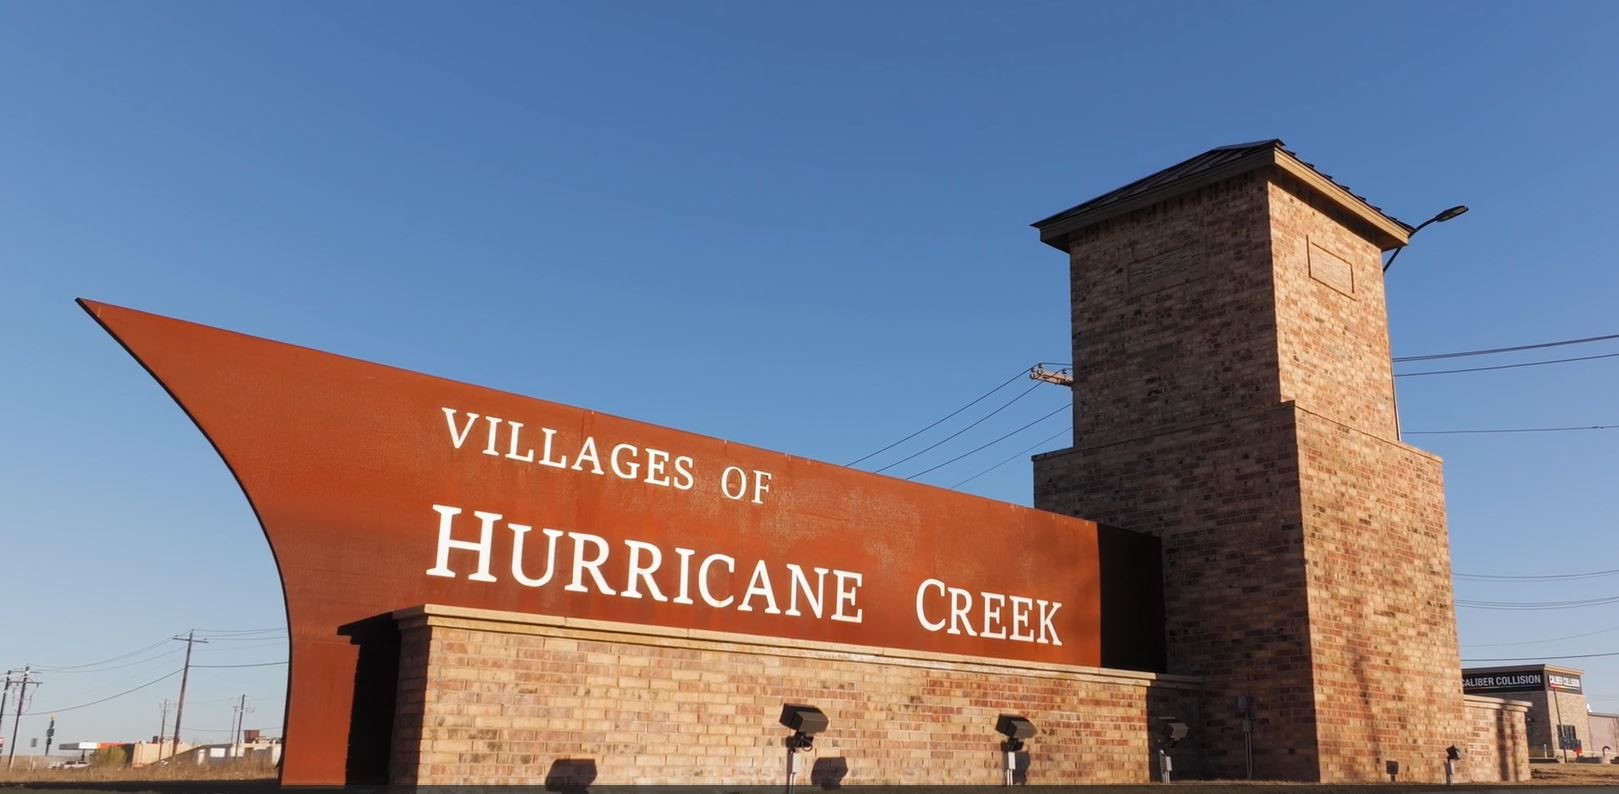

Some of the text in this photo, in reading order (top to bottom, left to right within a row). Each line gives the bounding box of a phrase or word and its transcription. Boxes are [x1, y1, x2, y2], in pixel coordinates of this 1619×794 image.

[441, 407, 772, 504] VILLAGES OF
[425, 504, 1063, 646] HURRICANE CREEK
[1495, 674, 1541, 686] COLLISION
